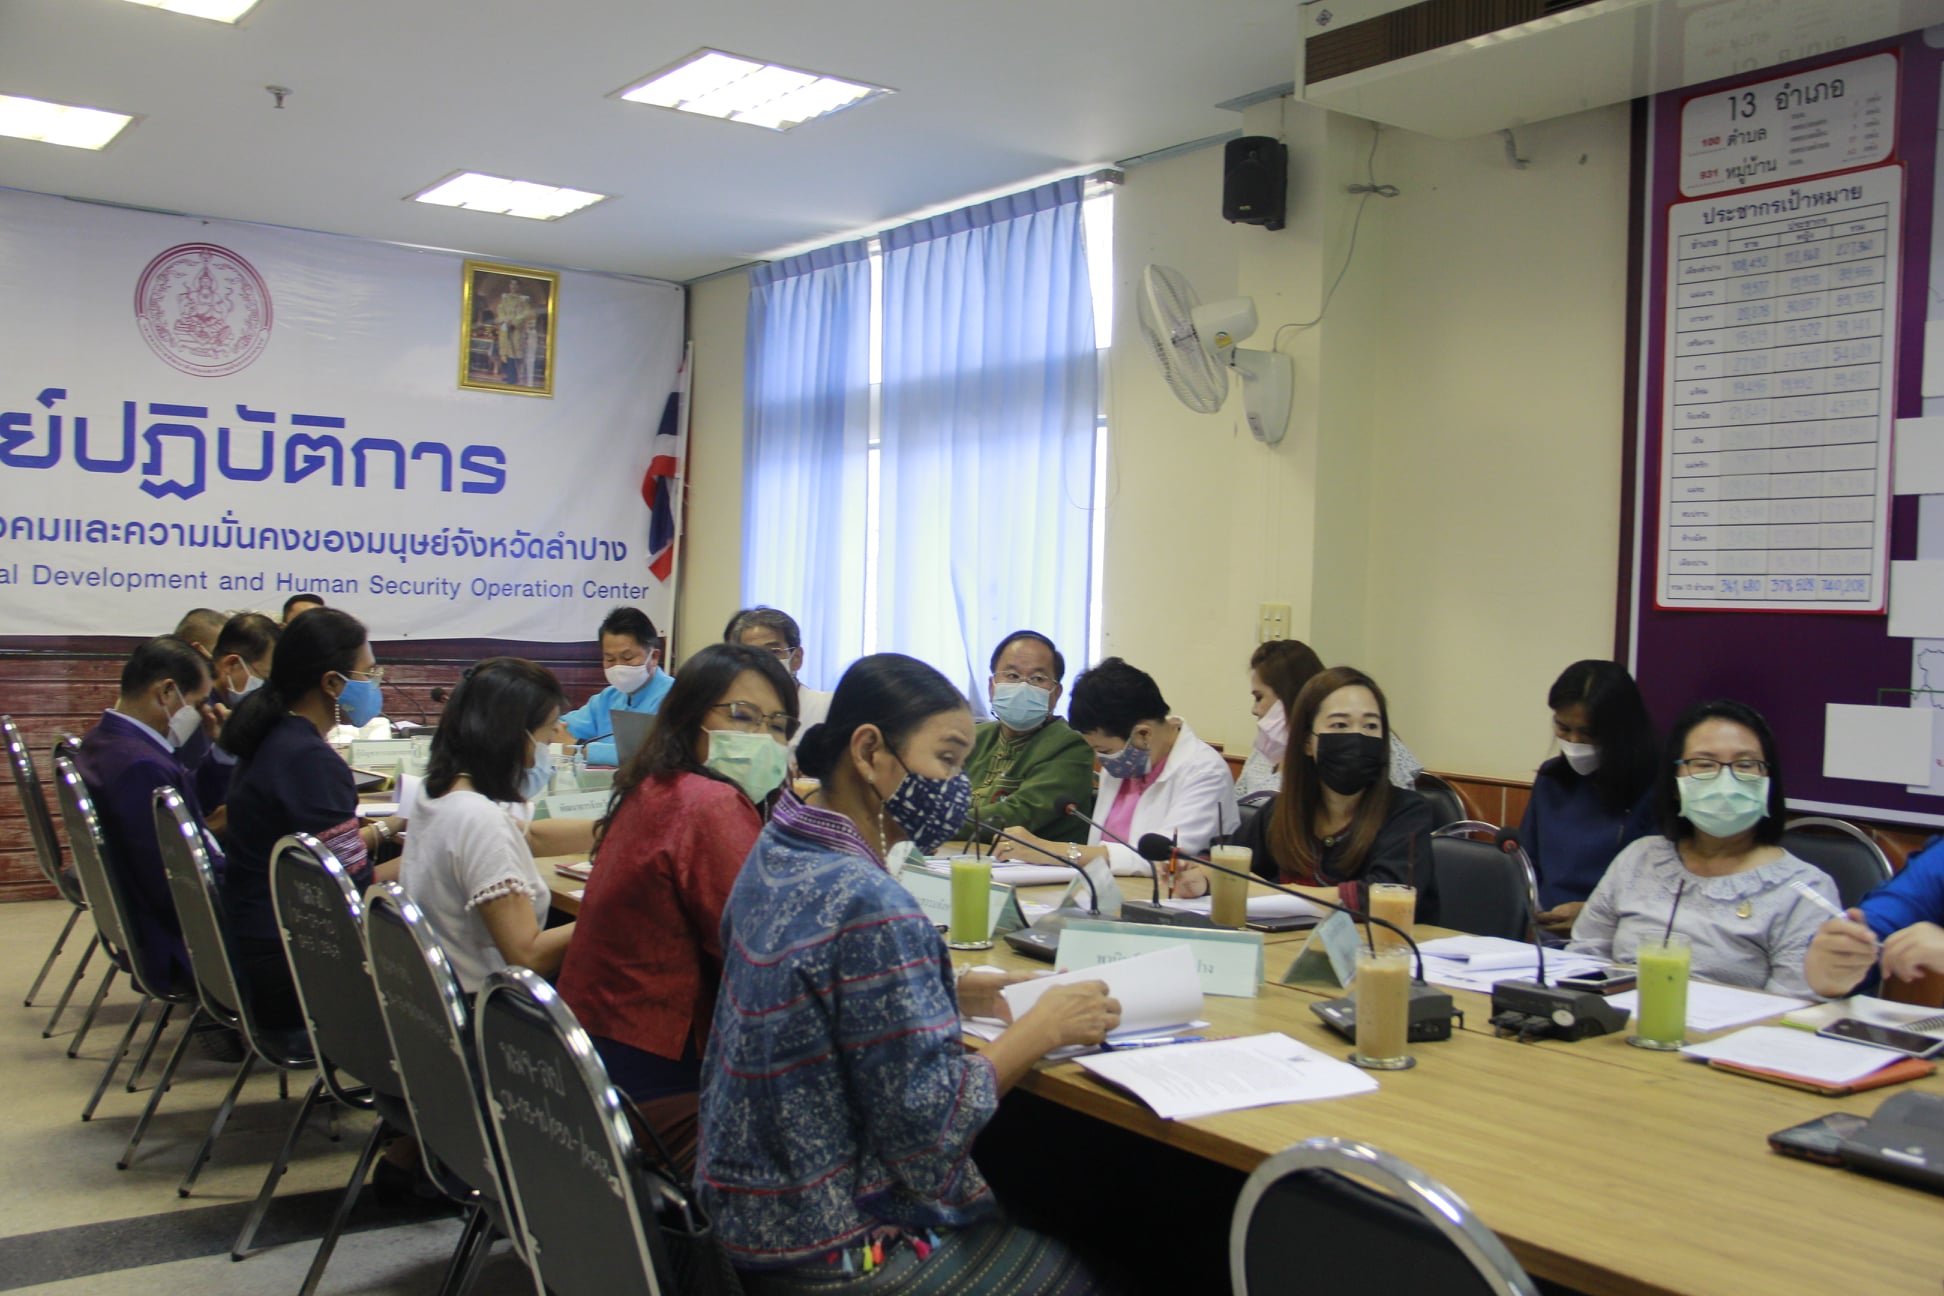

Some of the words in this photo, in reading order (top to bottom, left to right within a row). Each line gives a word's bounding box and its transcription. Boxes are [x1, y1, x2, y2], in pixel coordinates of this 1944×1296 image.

[1728, 91, 1758, 121] 13
[1775, 78, 1846, 111] อำเภอ
[1726, 127, 1768, 147] ตำบล
[1725, 155, 1779, 185] หมู่บ้าน
[1702, 185, 1863, 225] ประชากรเป้าหมาย
[33, 564, 207, 593] Development
[219, 572, 263, 591] and
[276, 574, 358, 595] Human
[370, 575, 461, 601] Security
[471, 577, 574, 603] Operation
[583, 581, 649, 600] Center
